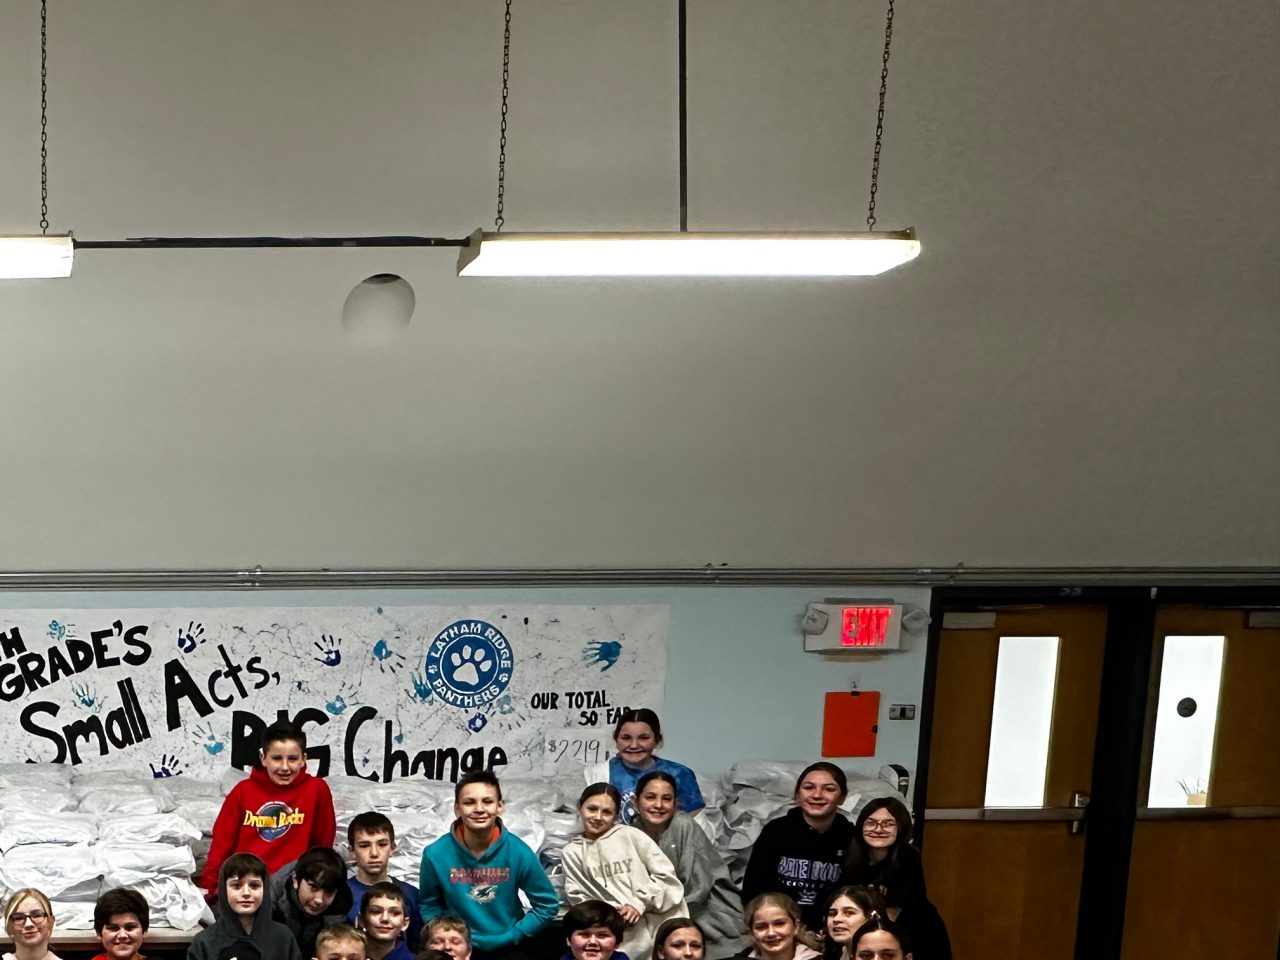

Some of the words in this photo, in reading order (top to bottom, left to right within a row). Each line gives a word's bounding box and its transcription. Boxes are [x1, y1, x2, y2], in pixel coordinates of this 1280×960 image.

[430, 622, 481, 658] LATHAM
[484, 627, 512, 668] RIDGE
[841, 608, 891, 646] EXIT
[19, 677, 151, 765] Small
[164, 644, 281, 731] Acts,
[432, 678, 500, 706] PANTHERS
[531, 692, 559, 710] OUR
[565, 690, 610, 709] TOTAL
[578, 711, 598, 726] SO
[344, 706, 508, 783] Change
